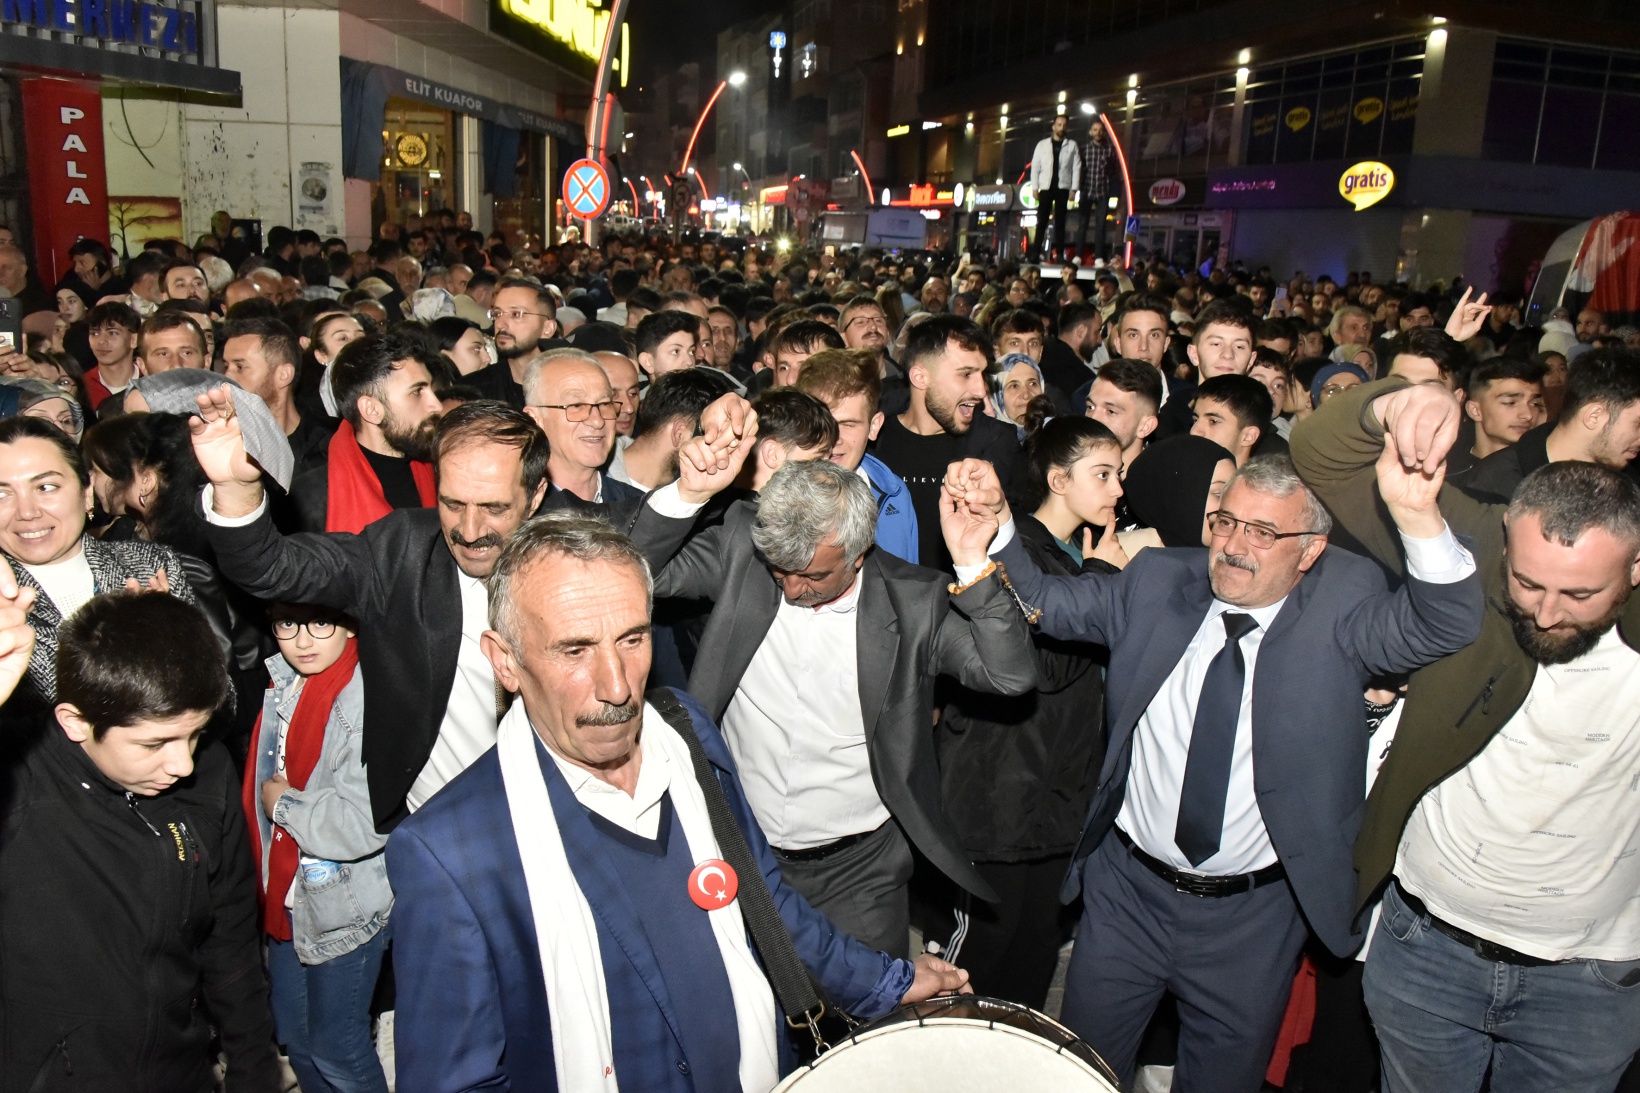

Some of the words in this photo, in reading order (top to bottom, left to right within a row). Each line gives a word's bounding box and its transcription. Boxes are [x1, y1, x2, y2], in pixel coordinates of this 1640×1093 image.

[405, 78, 431, 97] ELİT
[59, 106, 91, 205] PALA
[1344, 168, 1388, 195] gratis
